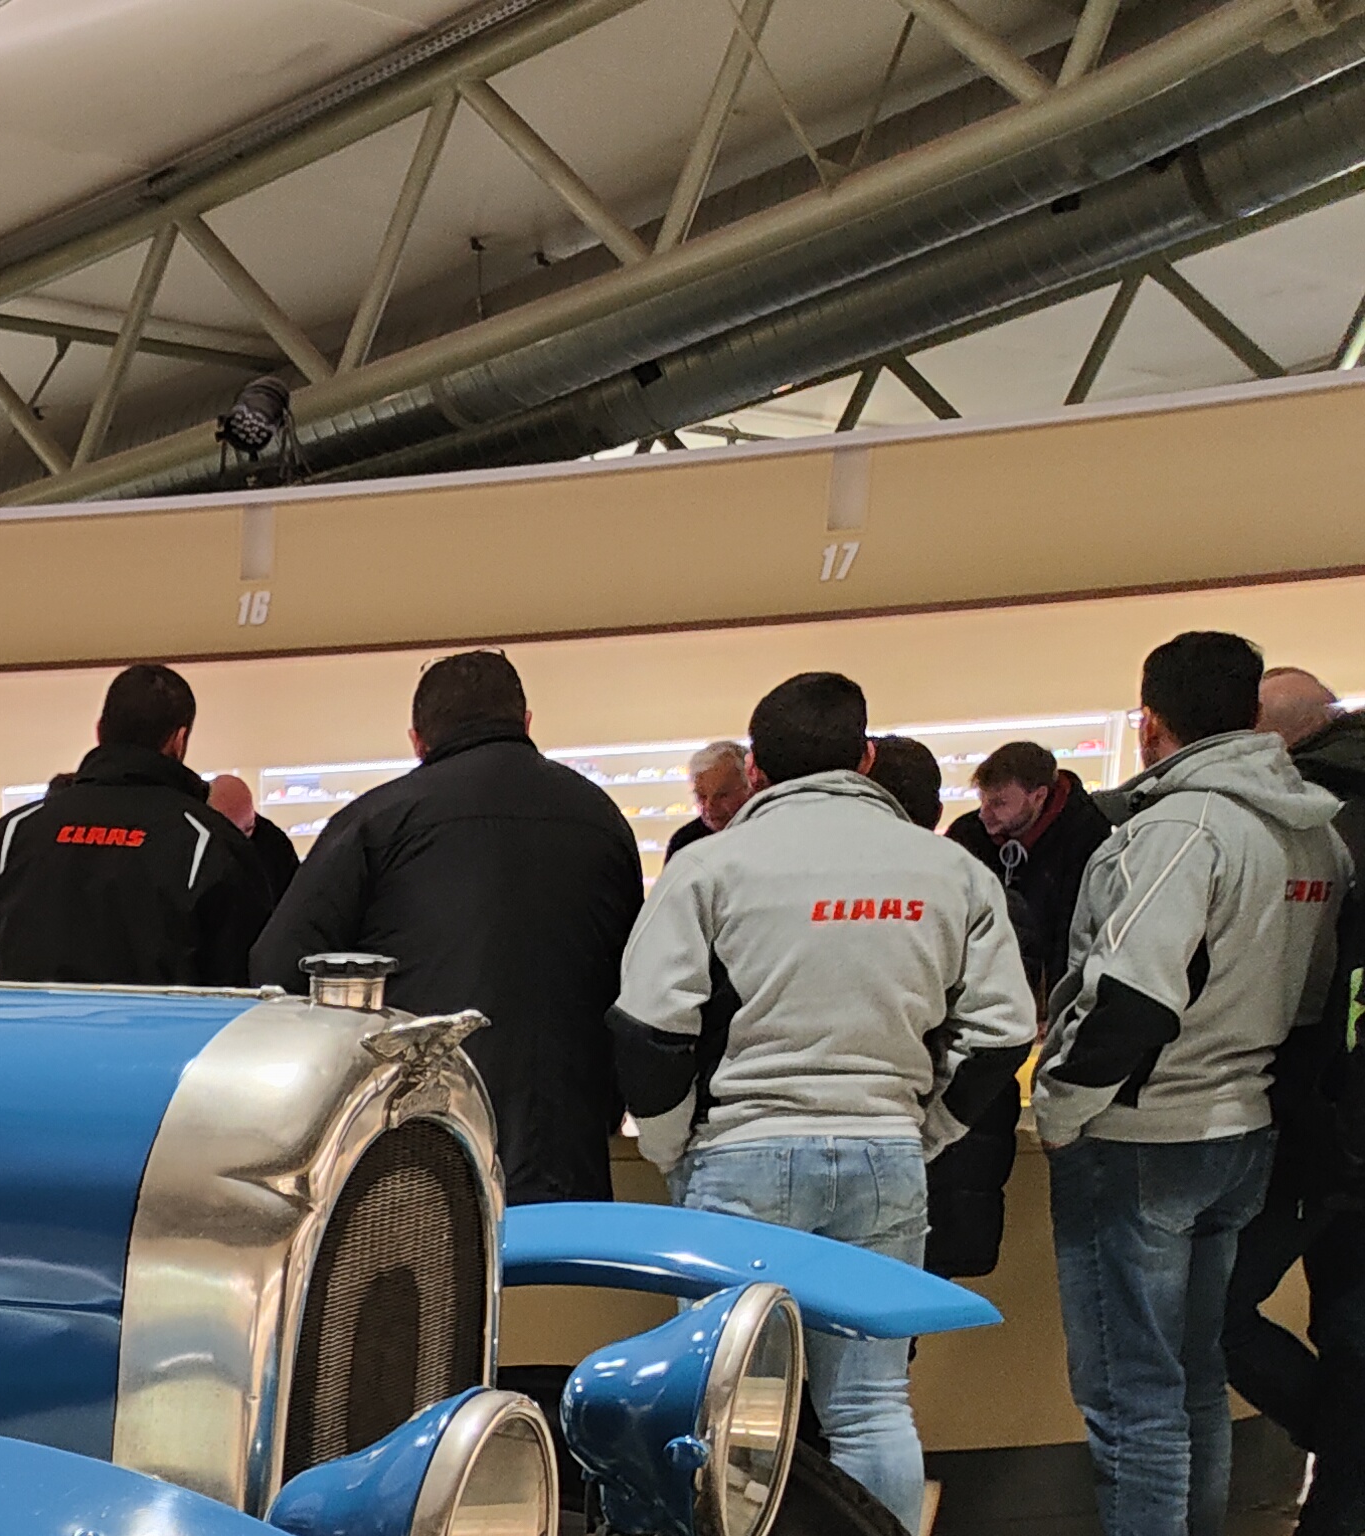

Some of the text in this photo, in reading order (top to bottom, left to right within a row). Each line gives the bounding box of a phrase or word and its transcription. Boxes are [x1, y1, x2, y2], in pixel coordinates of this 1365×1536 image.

[820, 541, 861, 581] 17
[237, 589, 272, 627] 16
[56, 823, 147, 849] CLAAS
[810, 897, 926, 923] CLAAS
